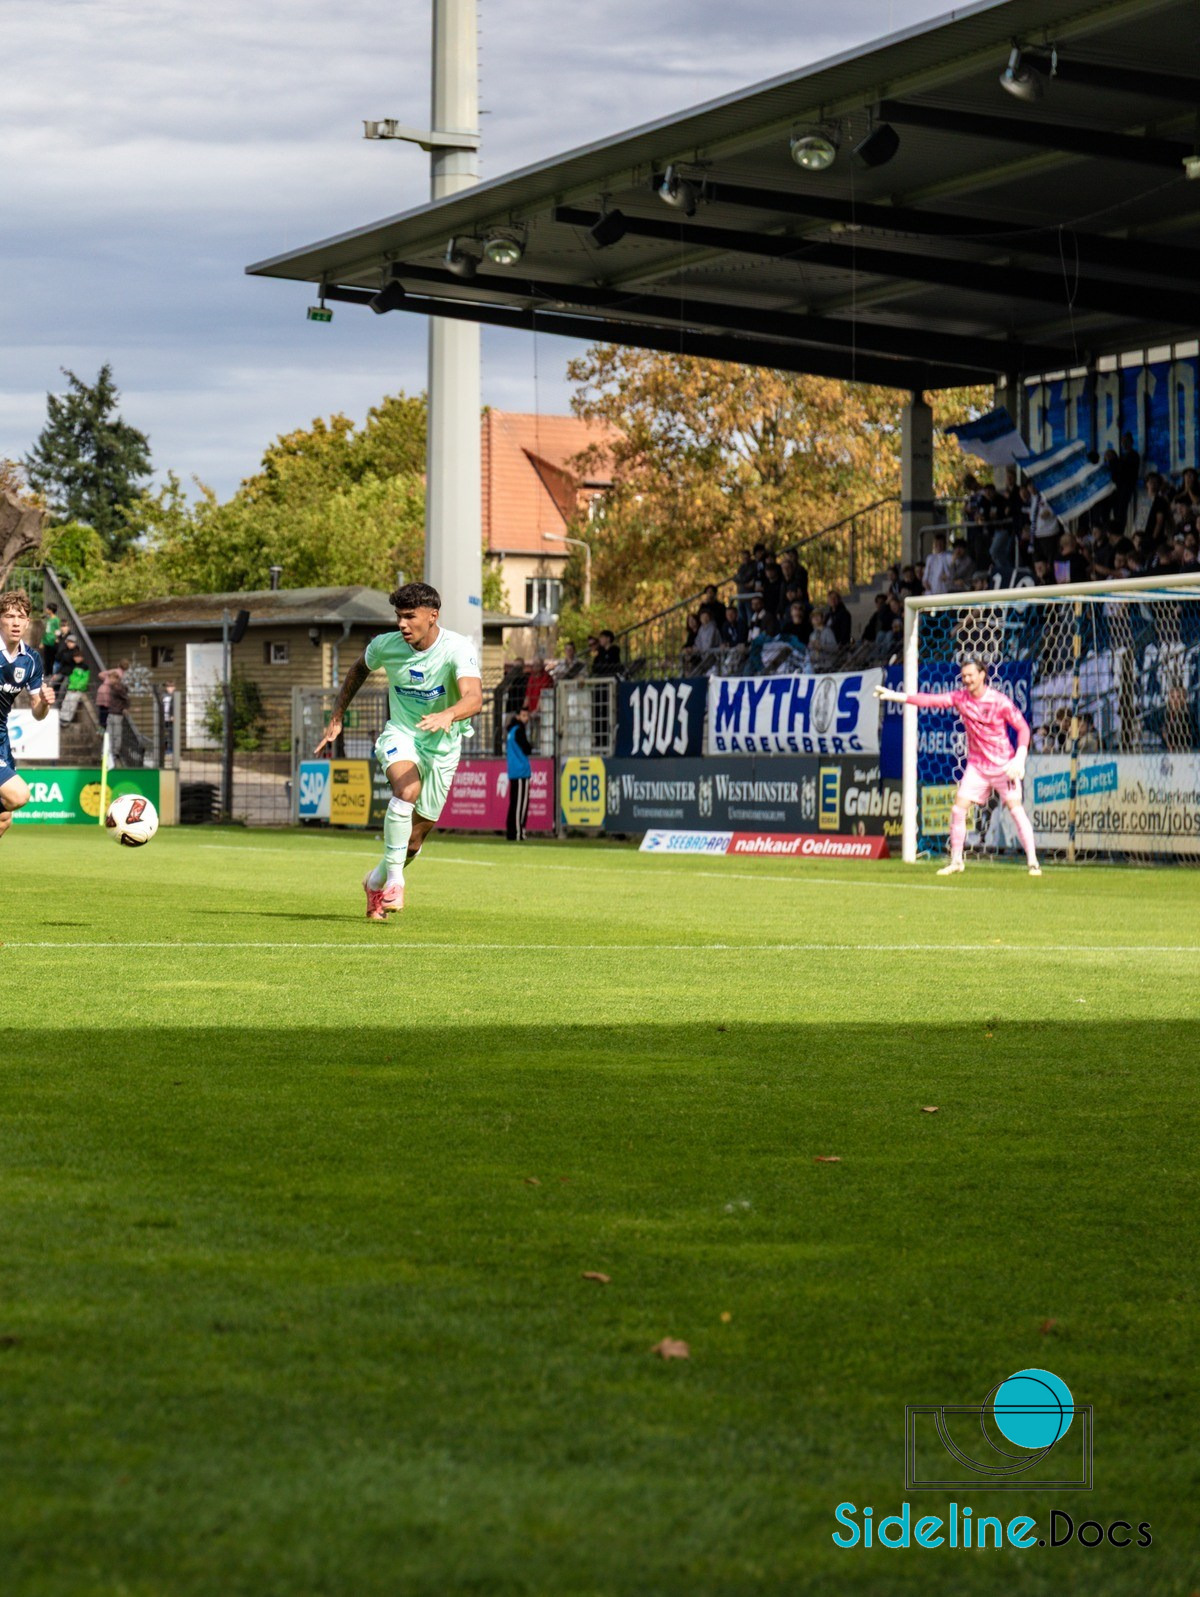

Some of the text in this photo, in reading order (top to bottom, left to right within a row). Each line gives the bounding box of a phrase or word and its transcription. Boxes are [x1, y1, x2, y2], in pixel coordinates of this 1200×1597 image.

[629, 682, 693, 757] 1903
[715, 675, 864, 734] MYTHOS
[716, 735, 864, 754] BABELSBERG
[300, 772, 325, 806] SAP
[332, 789, 366, 808] KÖNIG
[569, 774, 600, 802] PRB
[844, 786, 904, 817] Gable
[1033, 805, 1200, 837] supeerater.com/jobs
[735, 836, 872, 856] nahkauf Oelmann
